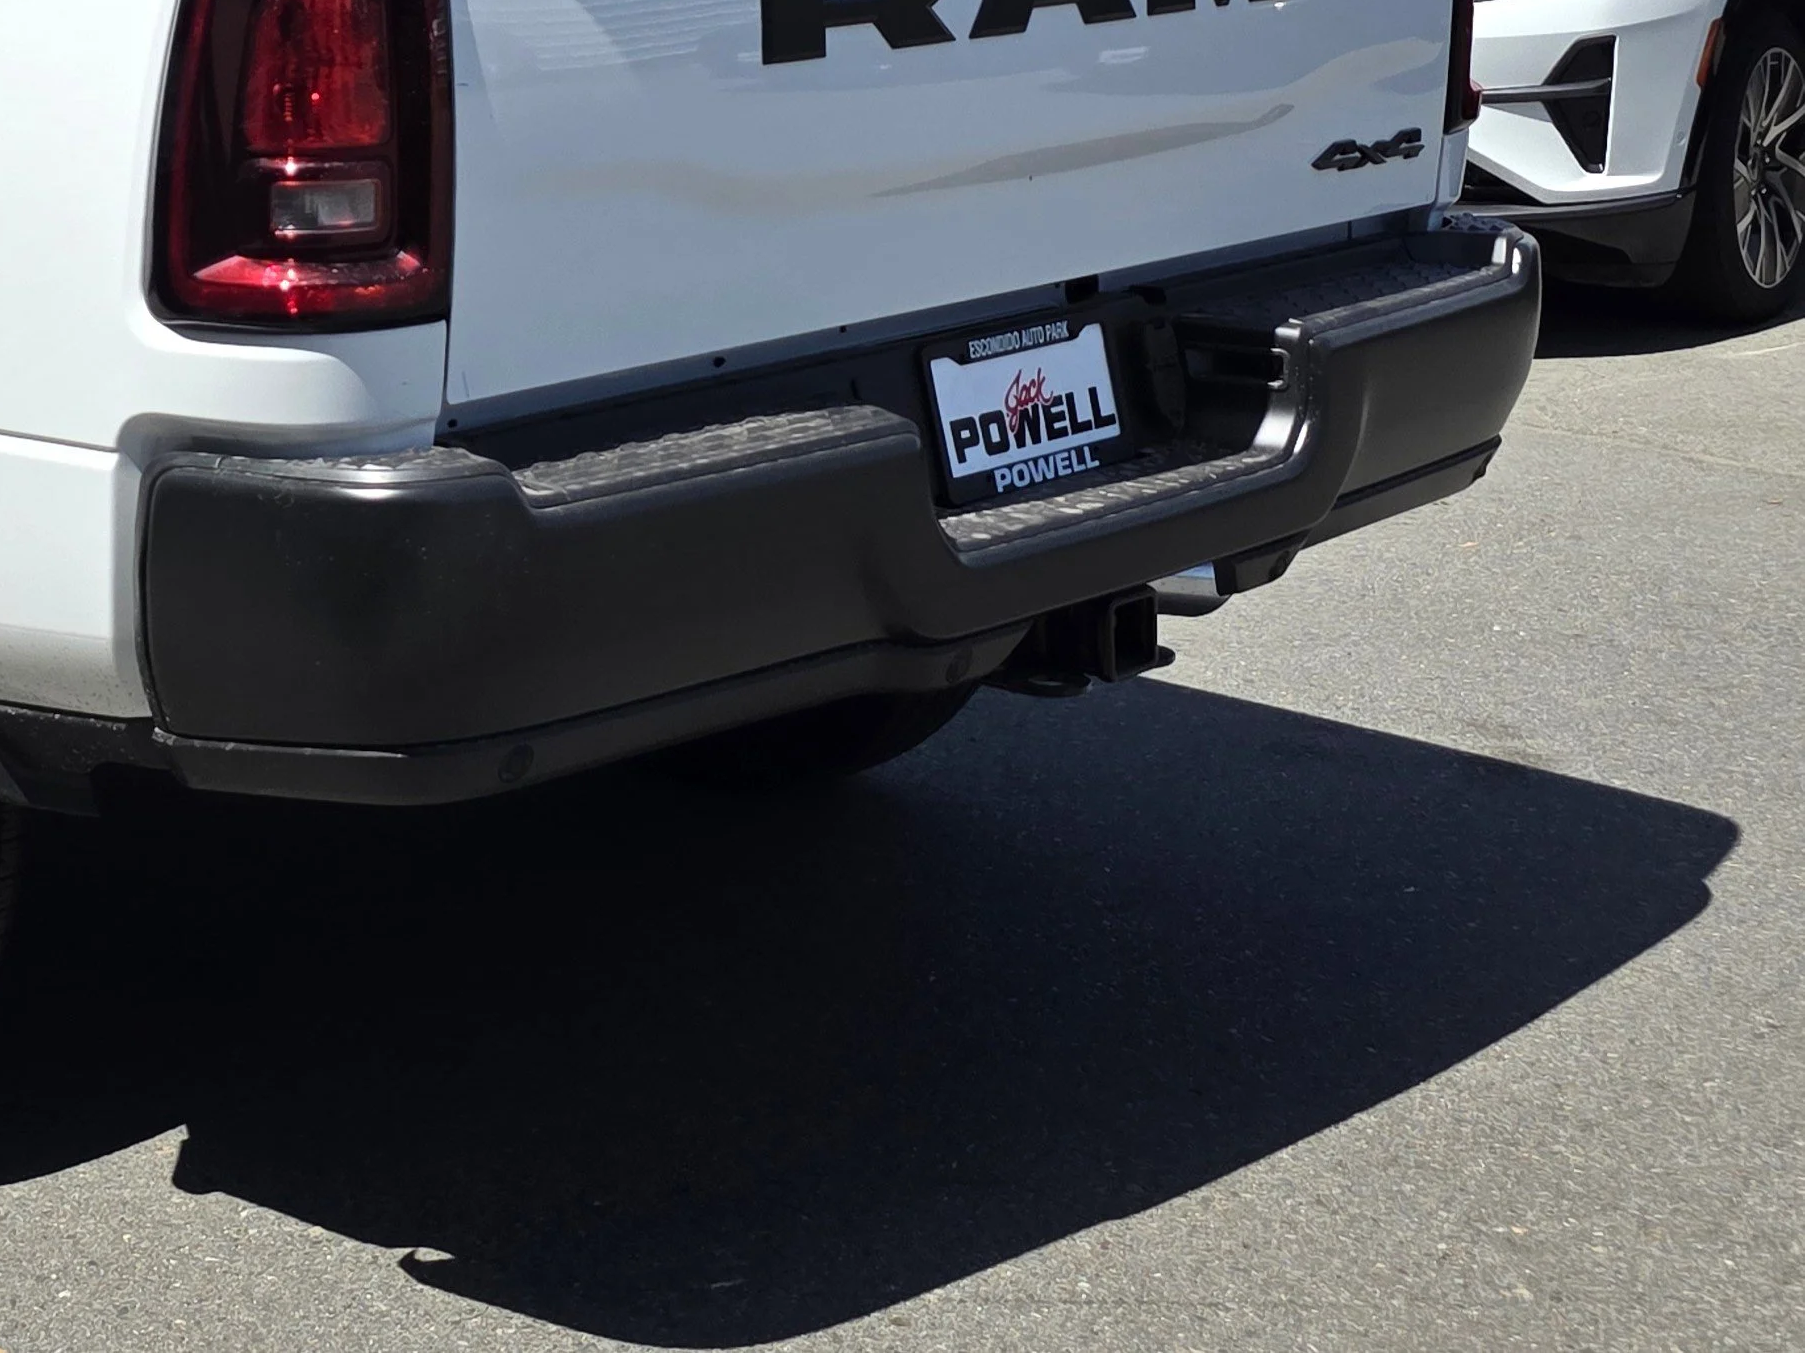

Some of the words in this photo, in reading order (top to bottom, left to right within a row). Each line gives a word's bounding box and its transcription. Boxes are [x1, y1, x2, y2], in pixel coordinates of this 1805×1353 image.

[969, 330, 1020, 359] ESCONDIDO
[1022, 325, 1044, 348] AUTO
[1045, 320, 1070, 342] PARK
[949, 386, 1116, 464] POWELL
[1005, 367, 1053, 434] Jack
[994, 446, 1100, 493] POWELL
